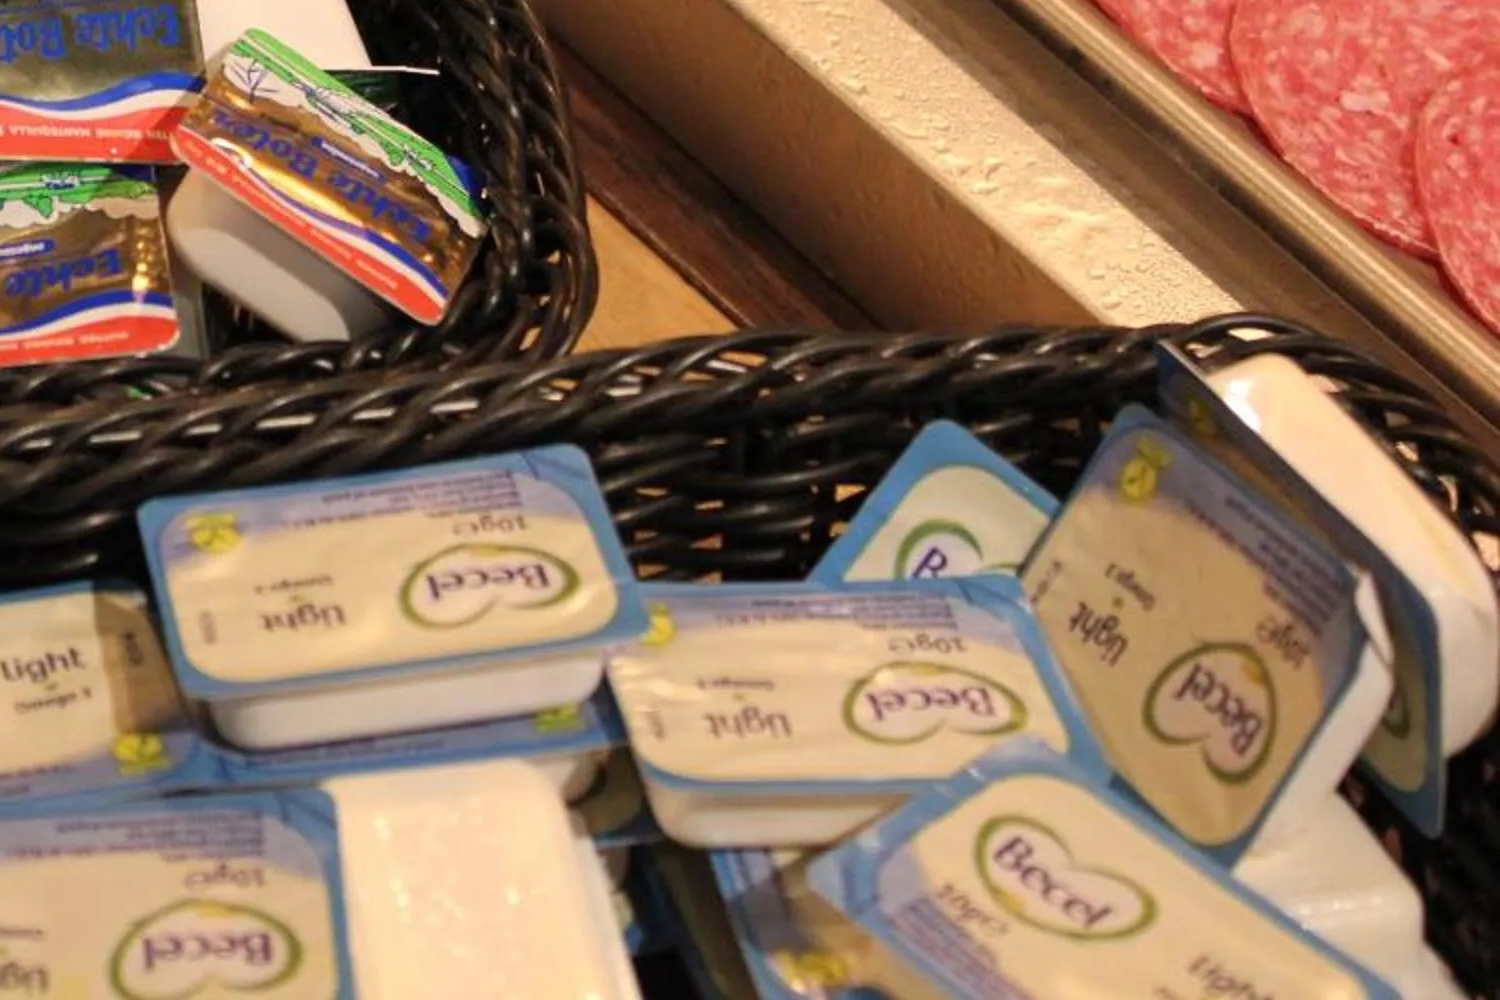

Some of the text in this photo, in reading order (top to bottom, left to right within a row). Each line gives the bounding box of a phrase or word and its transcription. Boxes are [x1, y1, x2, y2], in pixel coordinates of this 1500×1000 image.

[75, 3, 181, 50] Echte
[425, 562, 551, 602] Becel
[863, 687, 999, 723] Becel
[1174, 662, 1263, 757] Becel
[992, 835, 1116, 931] Becel
[141, 932, 274, 973] Becel
